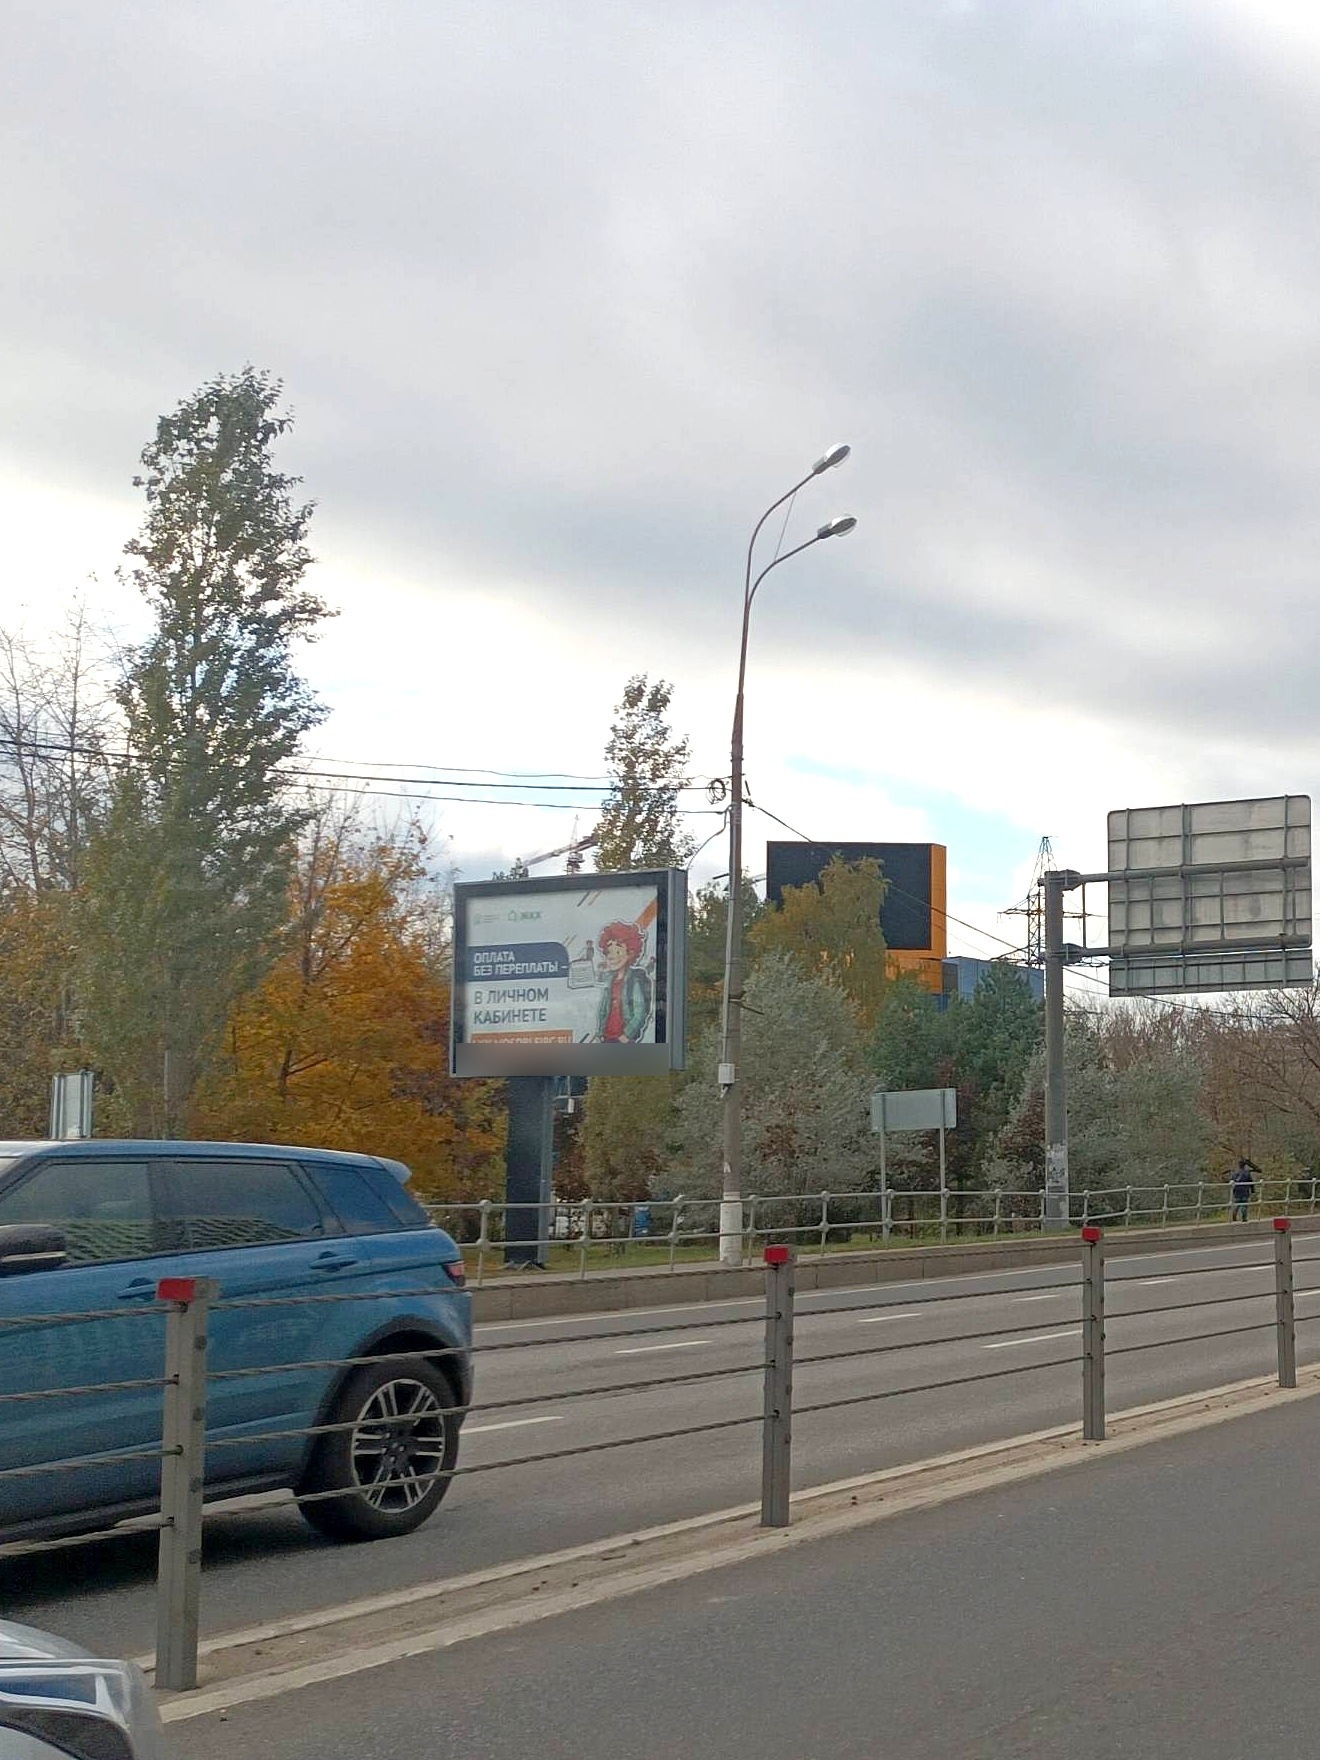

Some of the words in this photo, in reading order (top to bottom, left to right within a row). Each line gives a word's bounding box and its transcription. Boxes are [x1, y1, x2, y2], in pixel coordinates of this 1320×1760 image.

[474, 951, 515, 964] ОПЛАТА
[474, 964, 493, 976] БЕЗ
[494, 961, 558, 975] ПЕРЕПЛАТЫ
[474, 990, 483, 1005] В
[487, 987, 549, 1004] ЛИЧНОМ
[474, 1008, 547, 1025] КАБИНЕТЕ
